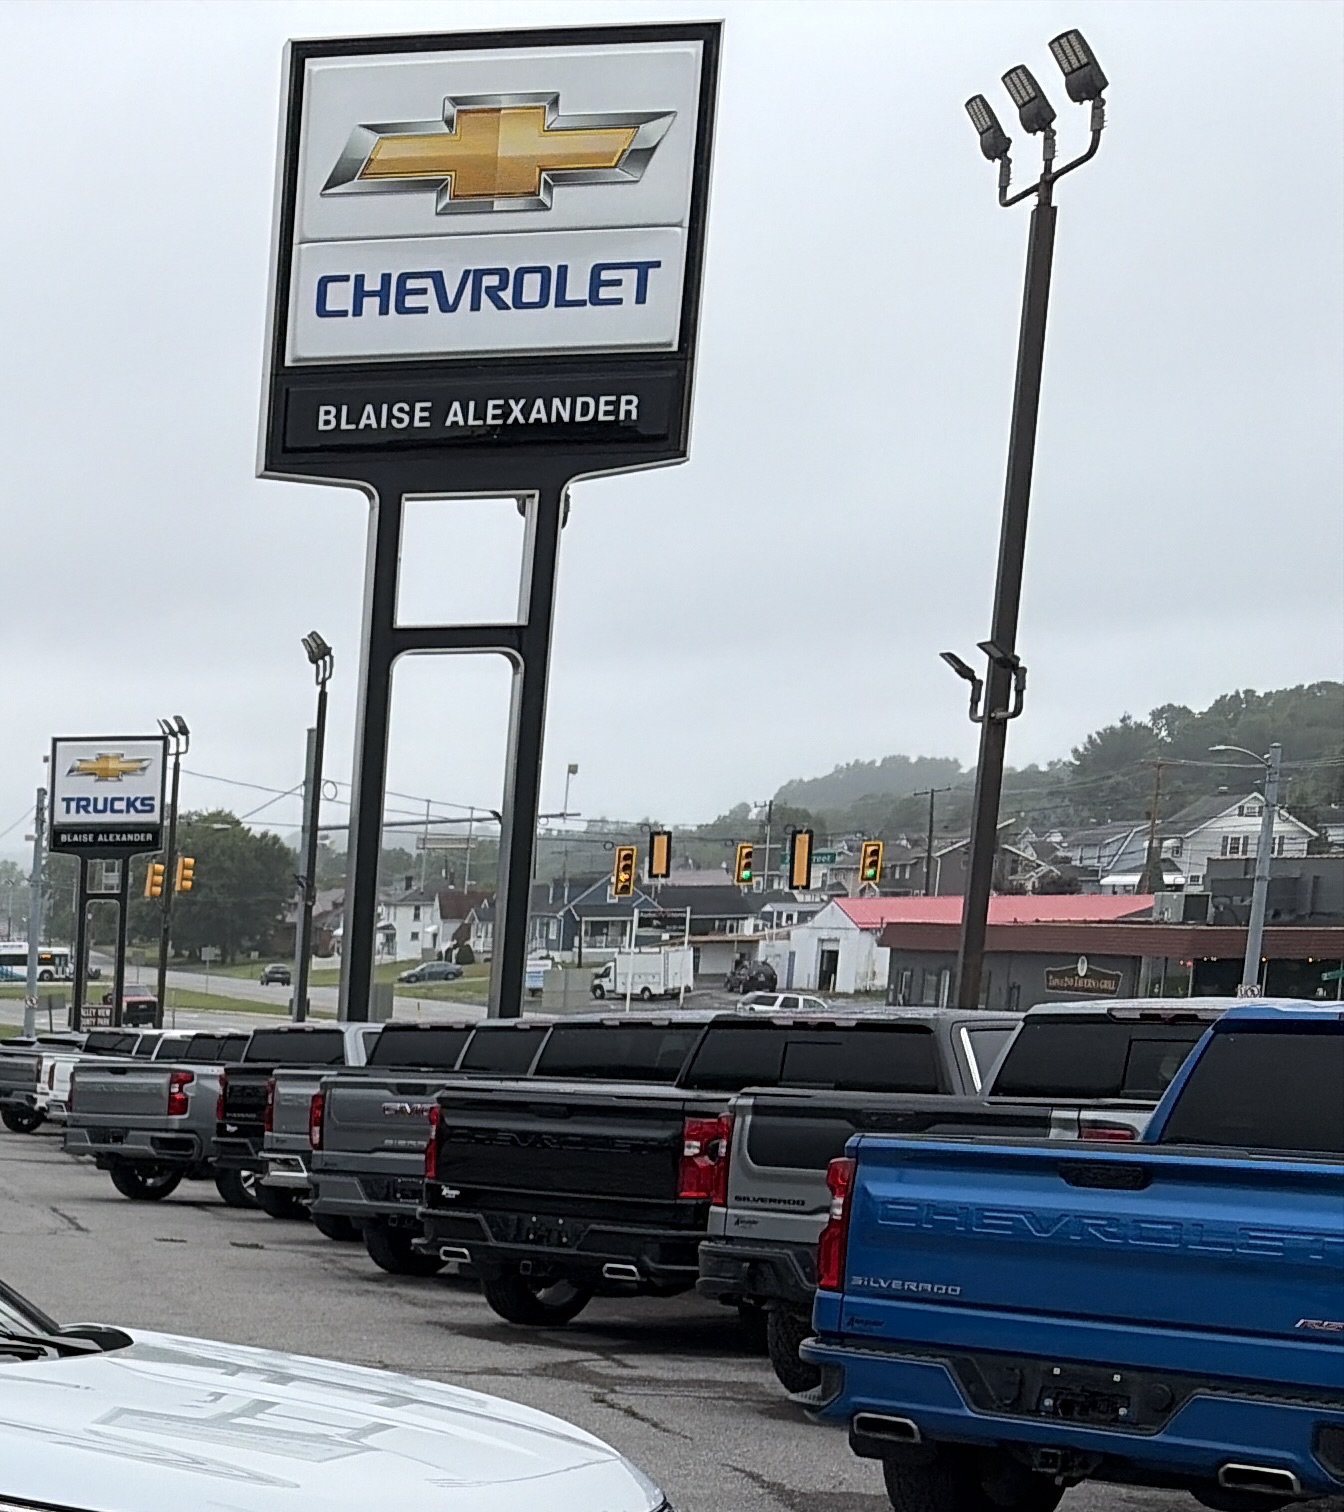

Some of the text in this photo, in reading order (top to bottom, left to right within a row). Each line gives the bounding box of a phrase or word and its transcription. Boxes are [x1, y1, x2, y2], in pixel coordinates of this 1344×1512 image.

[315, 260, 662, 319] CHEVROLET
[317, 394, 639, 431] BLAISE ALEXANDER
[61, 796, 155, 815] TRUCKS
[60, 832, 153, 843] BLAISE ALEXANDER
[734, 1194, 806, 1207] SILVERADO
[877, 1202, 1344, 1259] CHEVROLET
[851, 1276, 962, 1296] SILVERADO
